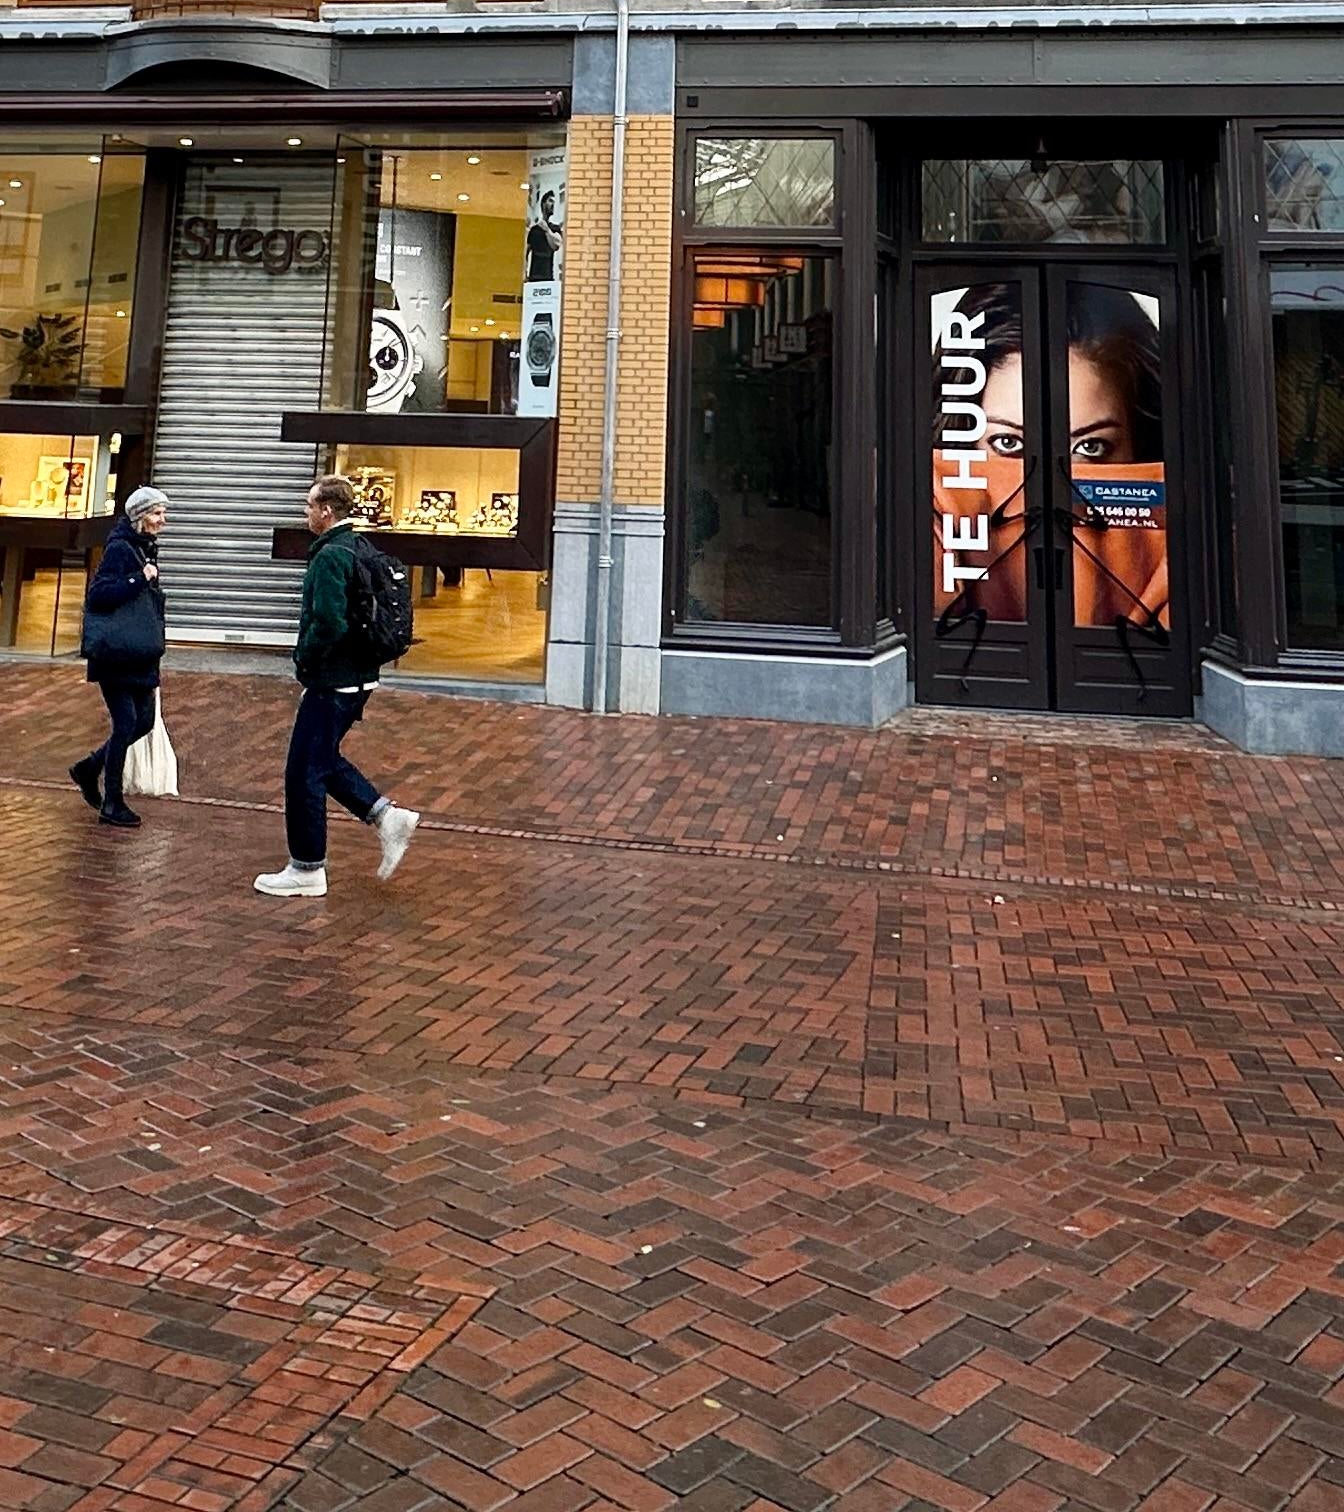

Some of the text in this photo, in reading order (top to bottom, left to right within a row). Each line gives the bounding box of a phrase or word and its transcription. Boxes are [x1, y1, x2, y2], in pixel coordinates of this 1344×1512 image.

[182, 217, 325, 275] Strego
[941, 311, 989, 593] TE HUUR
[1095, 487, 1157, 496] CASTANEA
